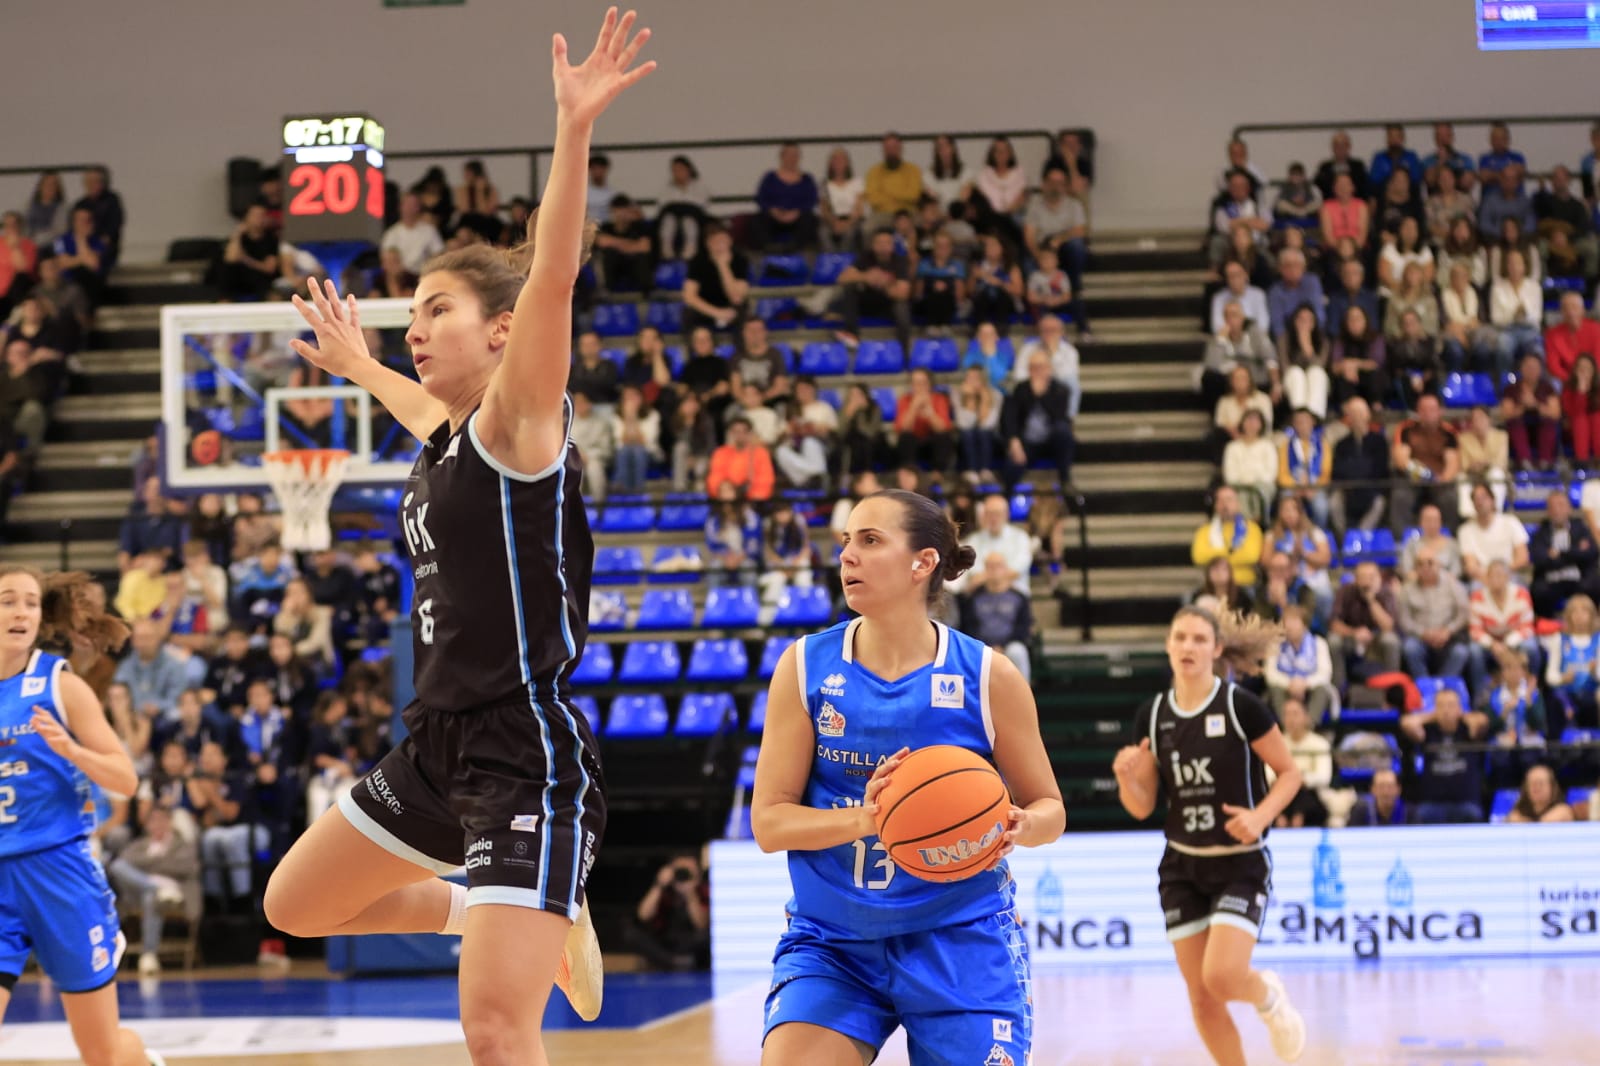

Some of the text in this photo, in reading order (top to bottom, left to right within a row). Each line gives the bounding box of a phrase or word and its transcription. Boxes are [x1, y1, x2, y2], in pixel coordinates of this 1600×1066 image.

[288, 163, 361, 216] 20
[418, 598, 435, 645] 6
[1183, 804, 1215, 833] 33
[851, 839, 896, 890] 13
